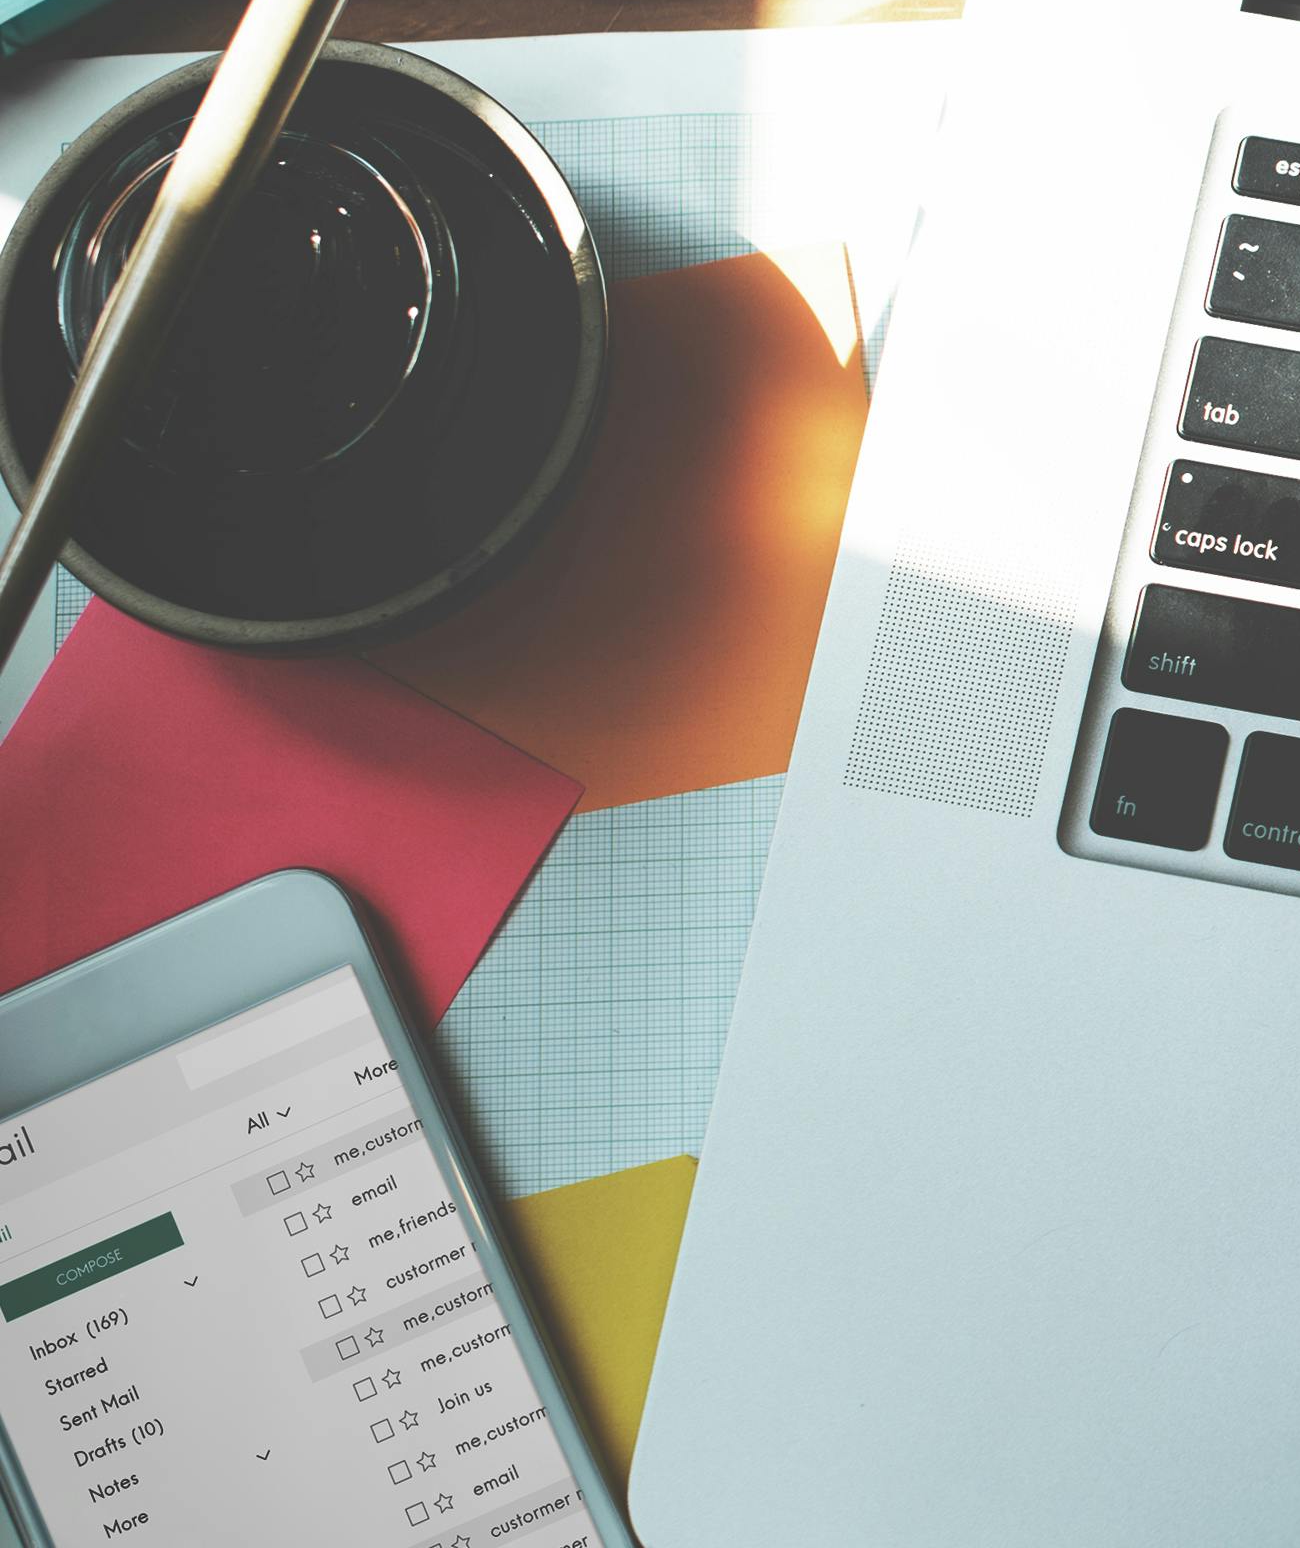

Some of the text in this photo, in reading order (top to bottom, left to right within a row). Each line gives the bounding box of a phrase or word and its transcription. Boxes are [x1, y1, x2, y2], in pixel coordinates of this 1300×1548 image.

[1204, 402, 1239, 425] tab
[1175, 530, 1278, 560] caps lock
[1149, 652, 1196, 675] shift
[1117, 796, 1135, 816] fn
[354, 1059, 399, 1085] More
[246, 1110, 270, 1134] All
[351, 1174, 398, 1207] email
[368, 1201, 457, 1249] me,friends
[56, 1248, 124, 1286] COMPOSE
[386, 1245, 466, 1289] custormer
[29, 1308, 129, 1361] Inbox (169)
[44, 1356, 109, 1396] Starred
[59, 1385, 141, 1432] Sent Mail
[438, 1382, 493, 1414] Join us
[73, 1418, 165, 1468] Drafts (10)
[88, 1474, 140, 1504] Notes
[473, 1463, 520, 1496] email
[103, 1512, 149, 1539] More
[490, 1494, 571, 1538] custormer
